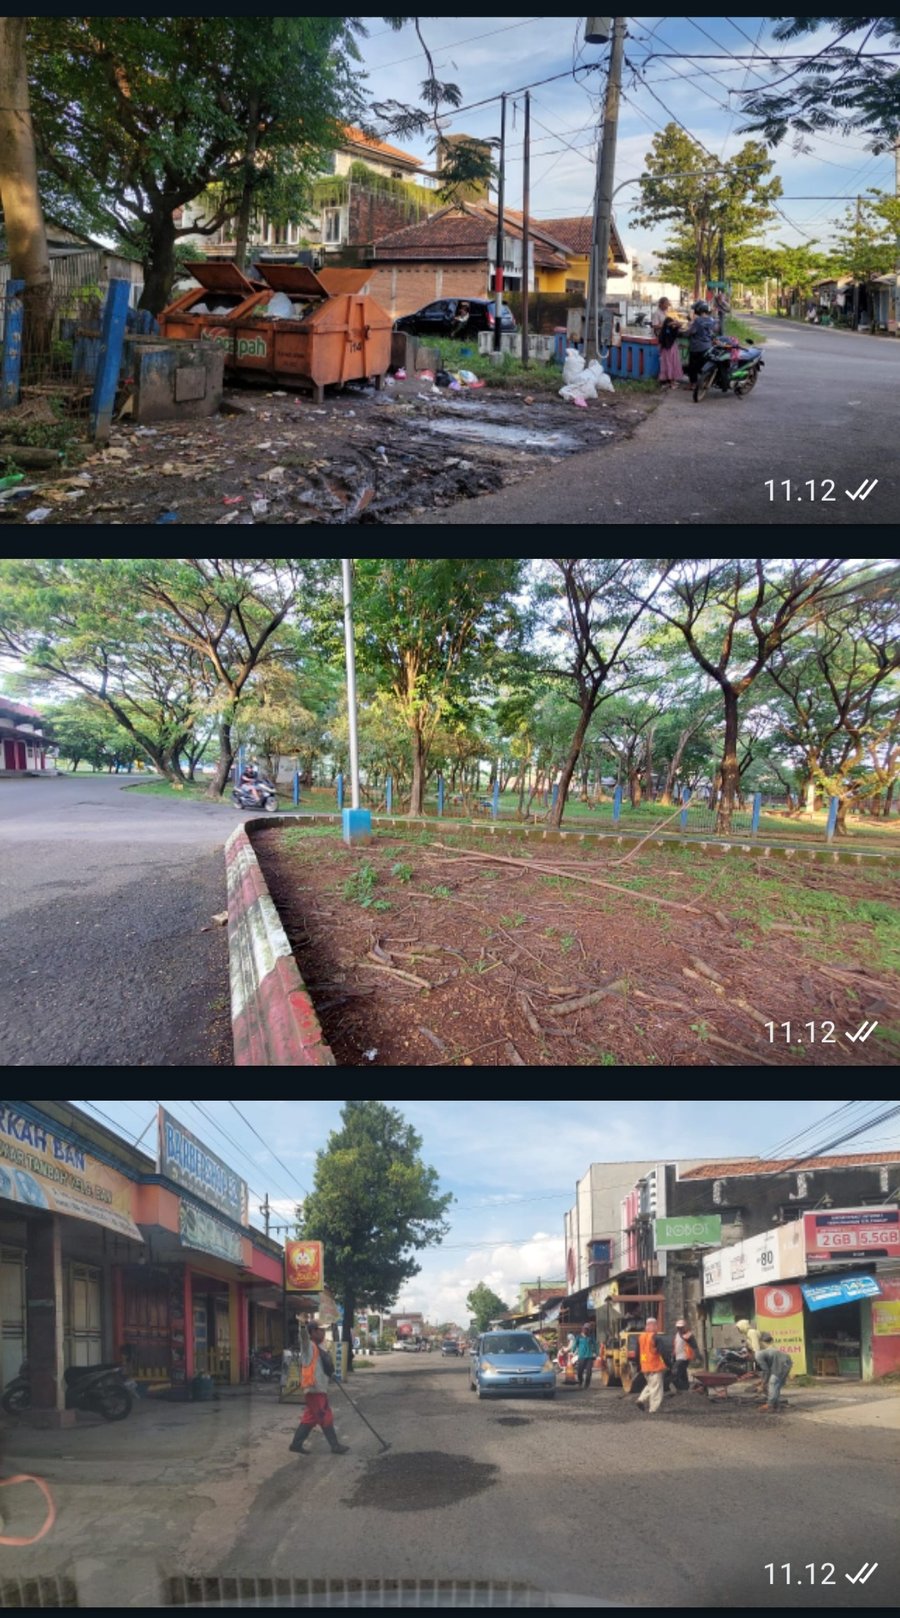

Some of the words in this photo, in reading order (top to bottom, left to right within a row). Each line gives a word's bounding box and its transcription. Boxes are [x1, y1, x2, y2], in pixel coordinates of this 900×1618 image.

[52, 1135, 86, 1173] BAN
[665, 1222, 709, 1238] ROBOT
[860, 1231, 898, 1244] 5.5GB
[822, 1235, 830, 1246] 2
[832, 1233, 851, 1245] GB
[760, 1250, 774, 1266] 80
